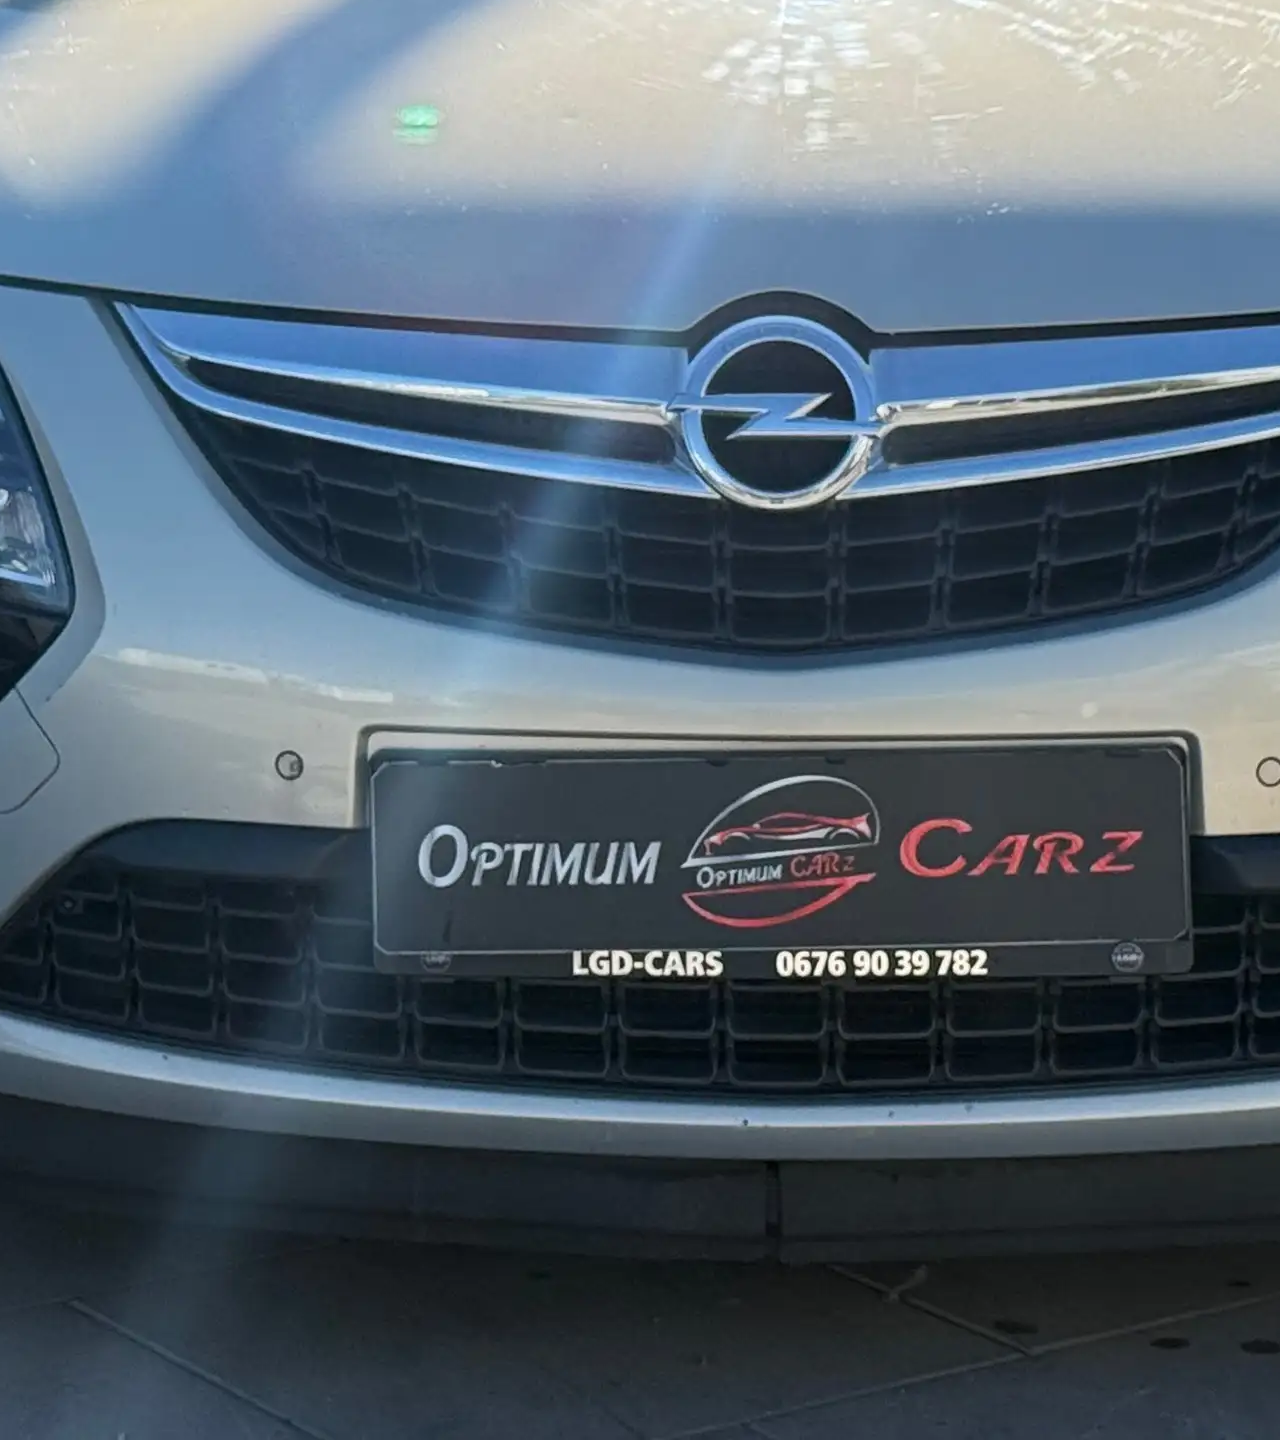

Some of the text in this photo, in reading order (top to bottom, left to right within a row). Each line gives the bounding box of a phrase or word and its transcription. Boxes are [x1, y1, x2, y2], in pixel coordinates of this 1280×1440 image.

[572, 948, 989, 977] LGD-CARS 0676 90 39 782
